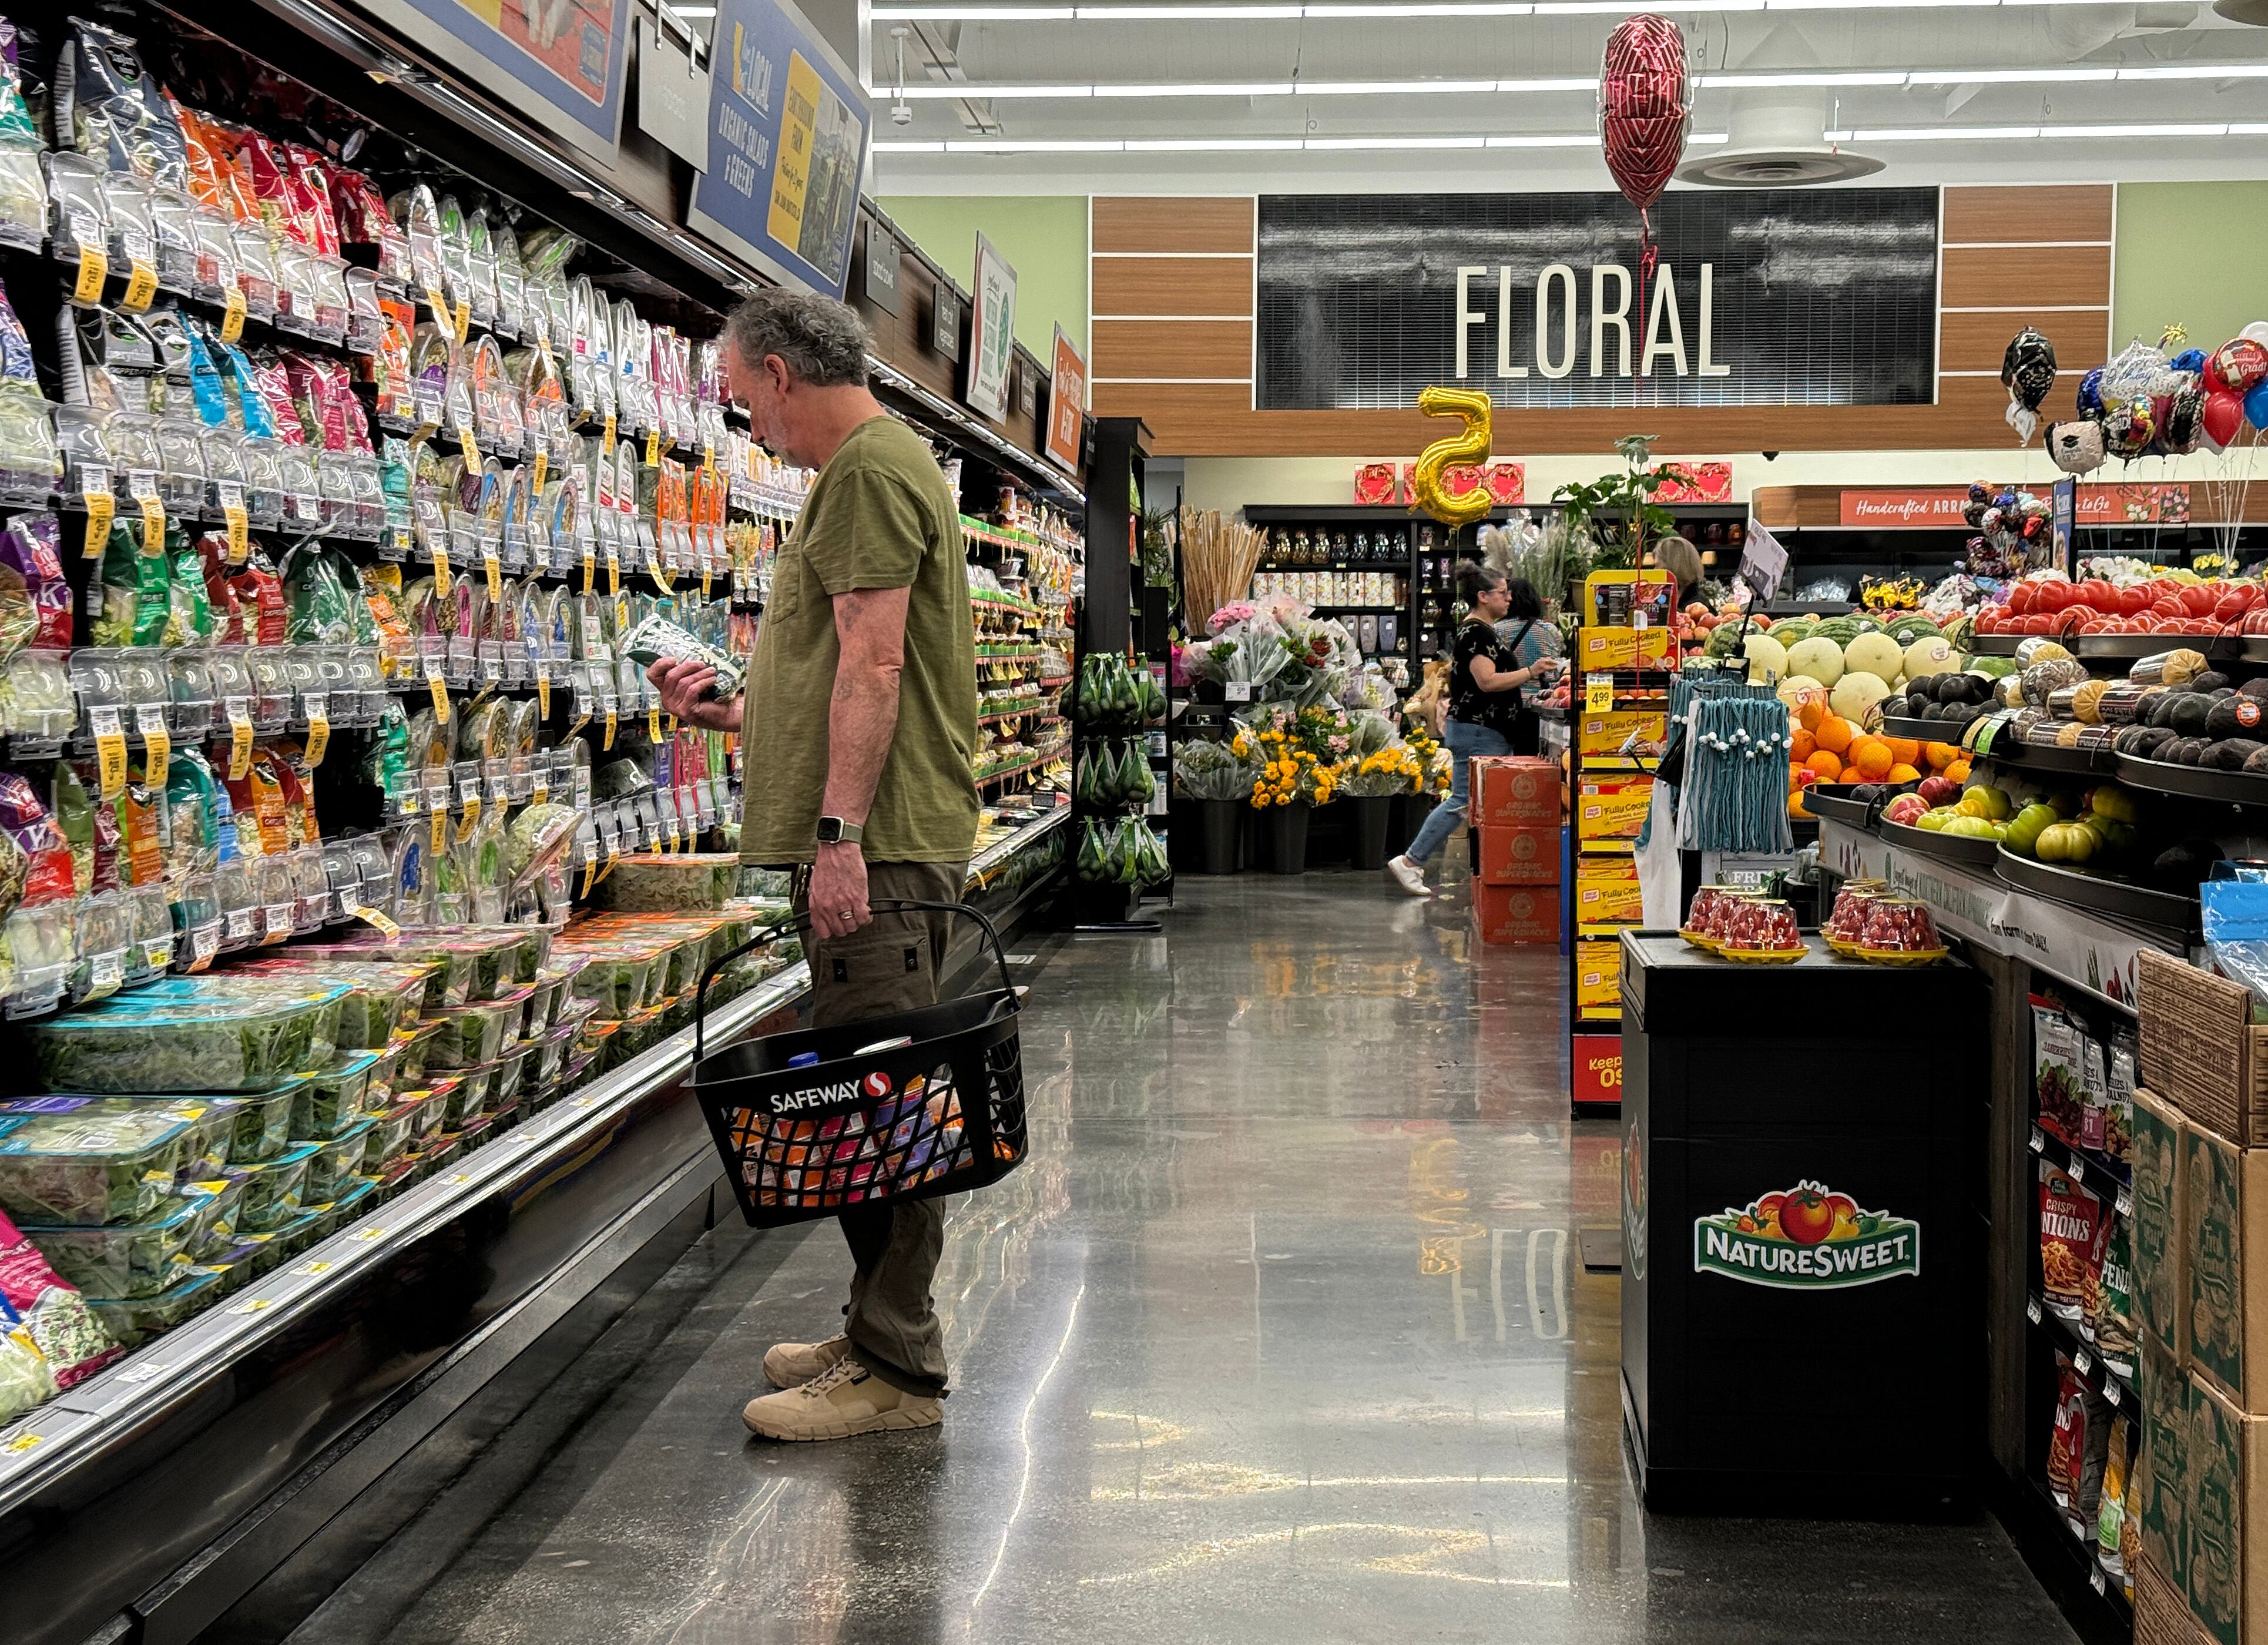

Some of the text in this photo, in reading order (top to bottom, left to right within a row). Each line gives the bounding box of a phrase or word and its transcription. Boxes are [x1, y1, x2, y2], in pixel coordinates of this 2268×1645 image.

[1455, 263, 1730, 378] FLORAL
[1856, 499, 1930, 521] Handcrafted
[1608, 631, 1661, 647] Fully Cooked
[1605, 715, 1657, 731] Fully Cooked
[1603, 800, 1650, 815] Fully Cooke
[1601, 889, 1622, 899] Fully
[1589, 1056, 1622, 1070] Keep
[771, 1080, 860, 1113] SAFEWAY
[2046, 1198, 2077, 1215] CRISPY
[2041, 1211, 2090, 1242] NIONS
[1707, 1227, 1910, 1278] NATURESWEET
